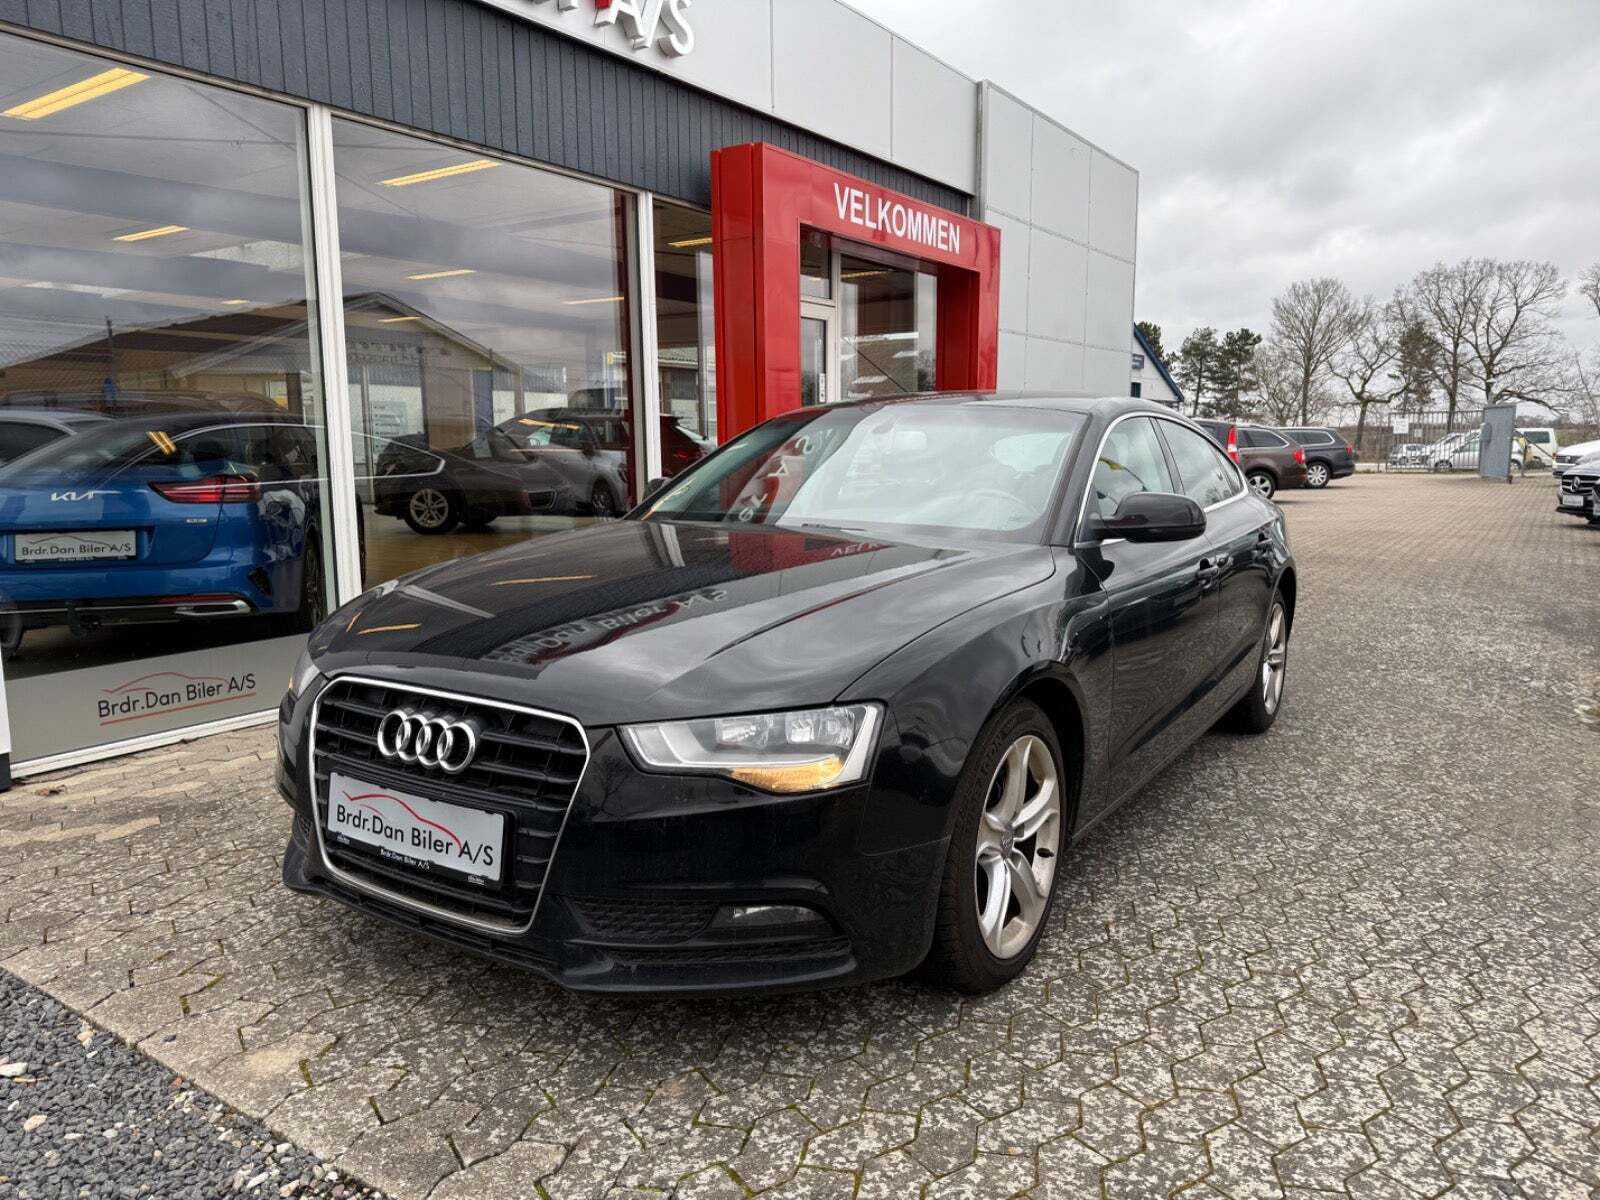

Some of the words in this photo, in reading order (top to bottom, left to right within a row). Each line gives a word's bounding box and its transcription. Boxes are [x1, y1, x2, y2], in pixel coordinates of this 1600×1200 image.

[833, 182, 960, 255] VELKOMMEN
[51, 491, 95, 501] KIA
[22, 546, 75, 556] Brdr.Dan
[80, 544, 105, 554] Biler
[109, 542, 132, 552] A/S
[98, 690, 181, 718] Brdr.Dan
[186, 682, 223, 701] Biler
[228, 673, 257, 693] A/S
[337, 804, 404, 842] Brdr.Dan
[411, 827, 453, 855] Biler
[458, 839, 494, 866] A/S
